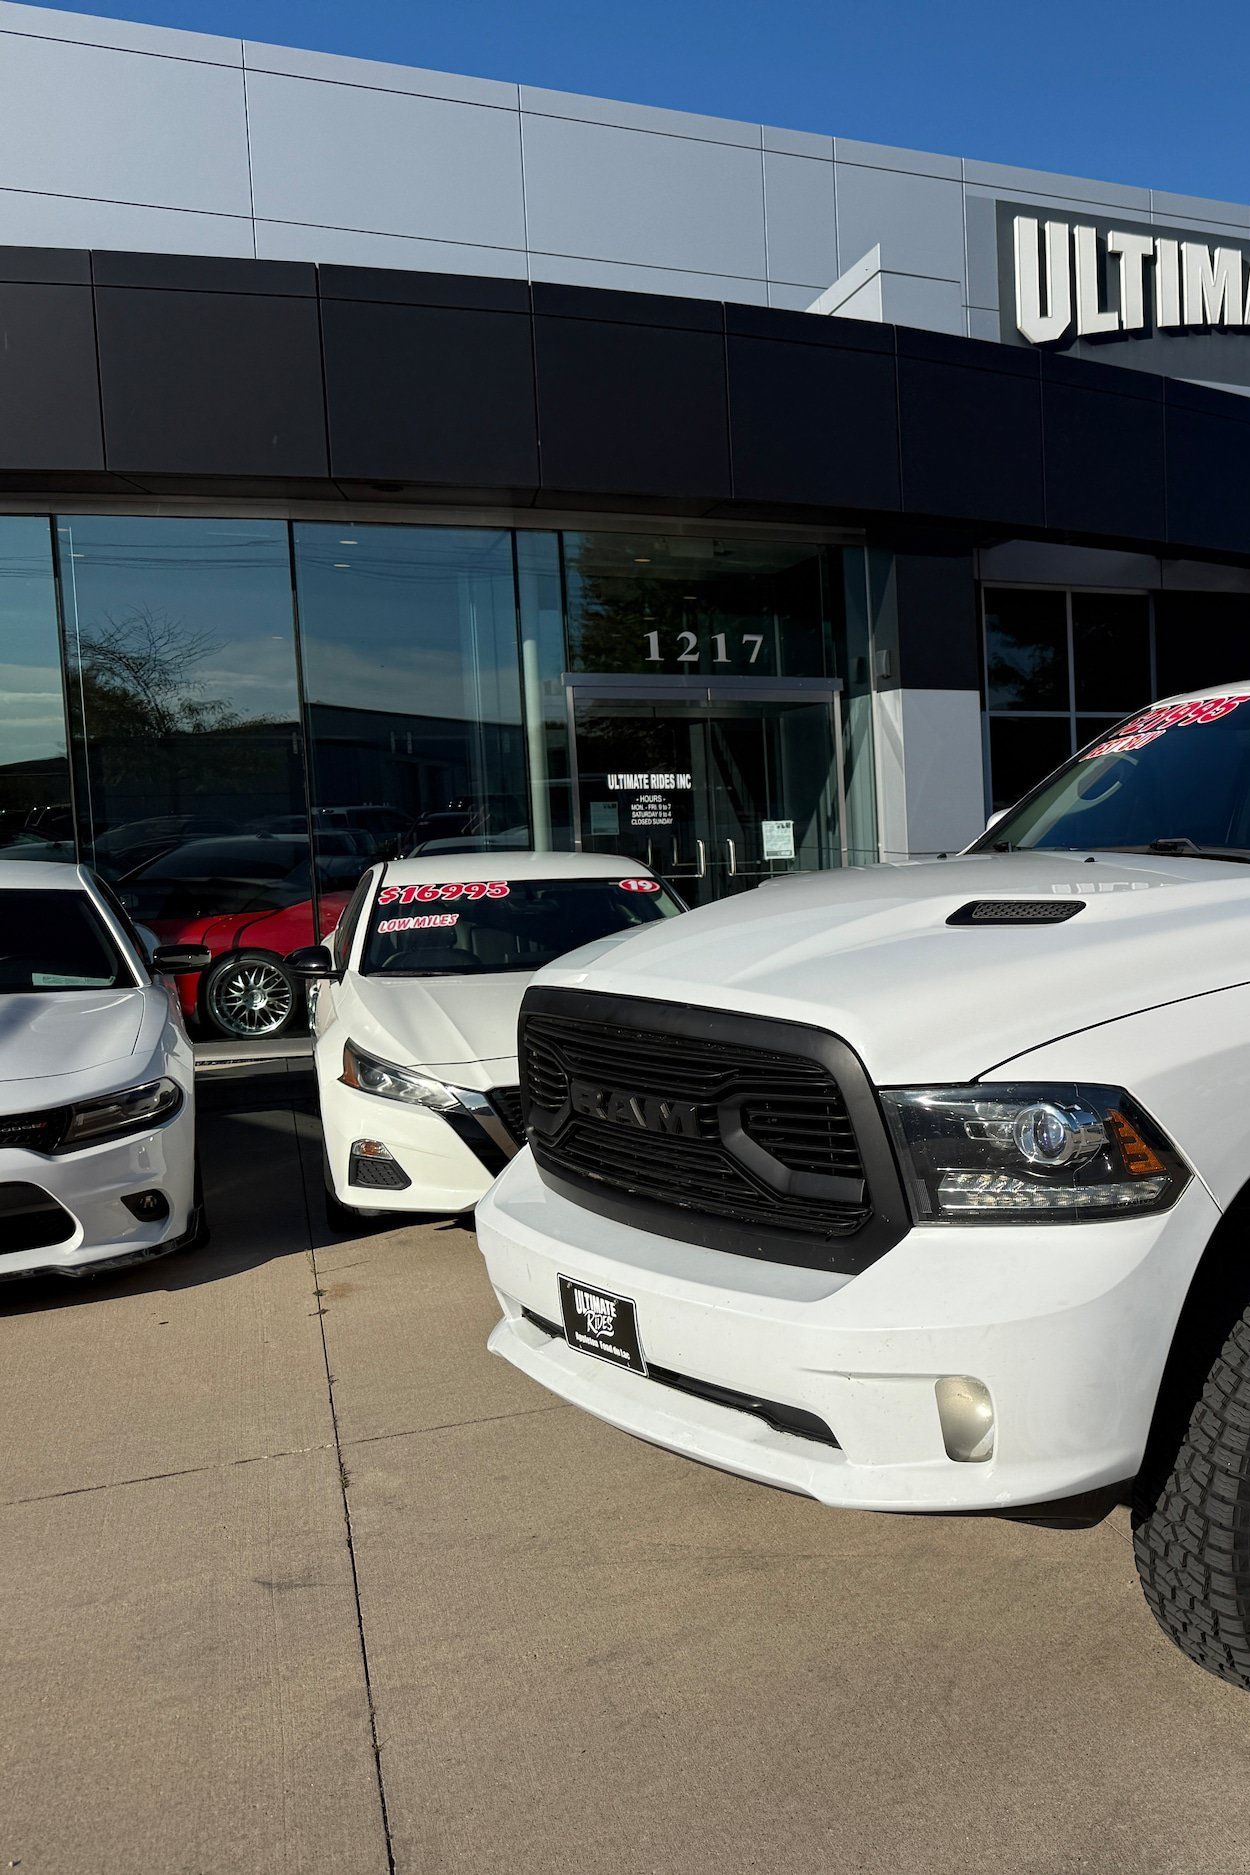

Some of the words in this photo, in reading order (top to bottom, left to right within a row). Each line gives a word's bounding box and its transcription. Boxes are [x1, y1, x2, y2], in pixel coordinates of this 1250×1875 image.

[643, 630, 764, 663] 1217
[607, 773, 649, 790] ULTIMATE
[650, 773, 675, 790] RIDES
[676, 773, 692, 790] INC
[640, 795, 663, 803] HOURS
[631, 818, 652, 826] CLOSED
[652, 818, 674, 826] SUNDAY
[378, 881, 510, 905] $16995
[628, 879, 653, 891] 19
[378, 917, 413, 934] LOW
[412, 913, 460, 929] MILES
[576, 1083, 700, 1137] RAM
[574, 1288, 617, 1318] ULTIMATE
[584, 1309, 614, 1336] RIDES
